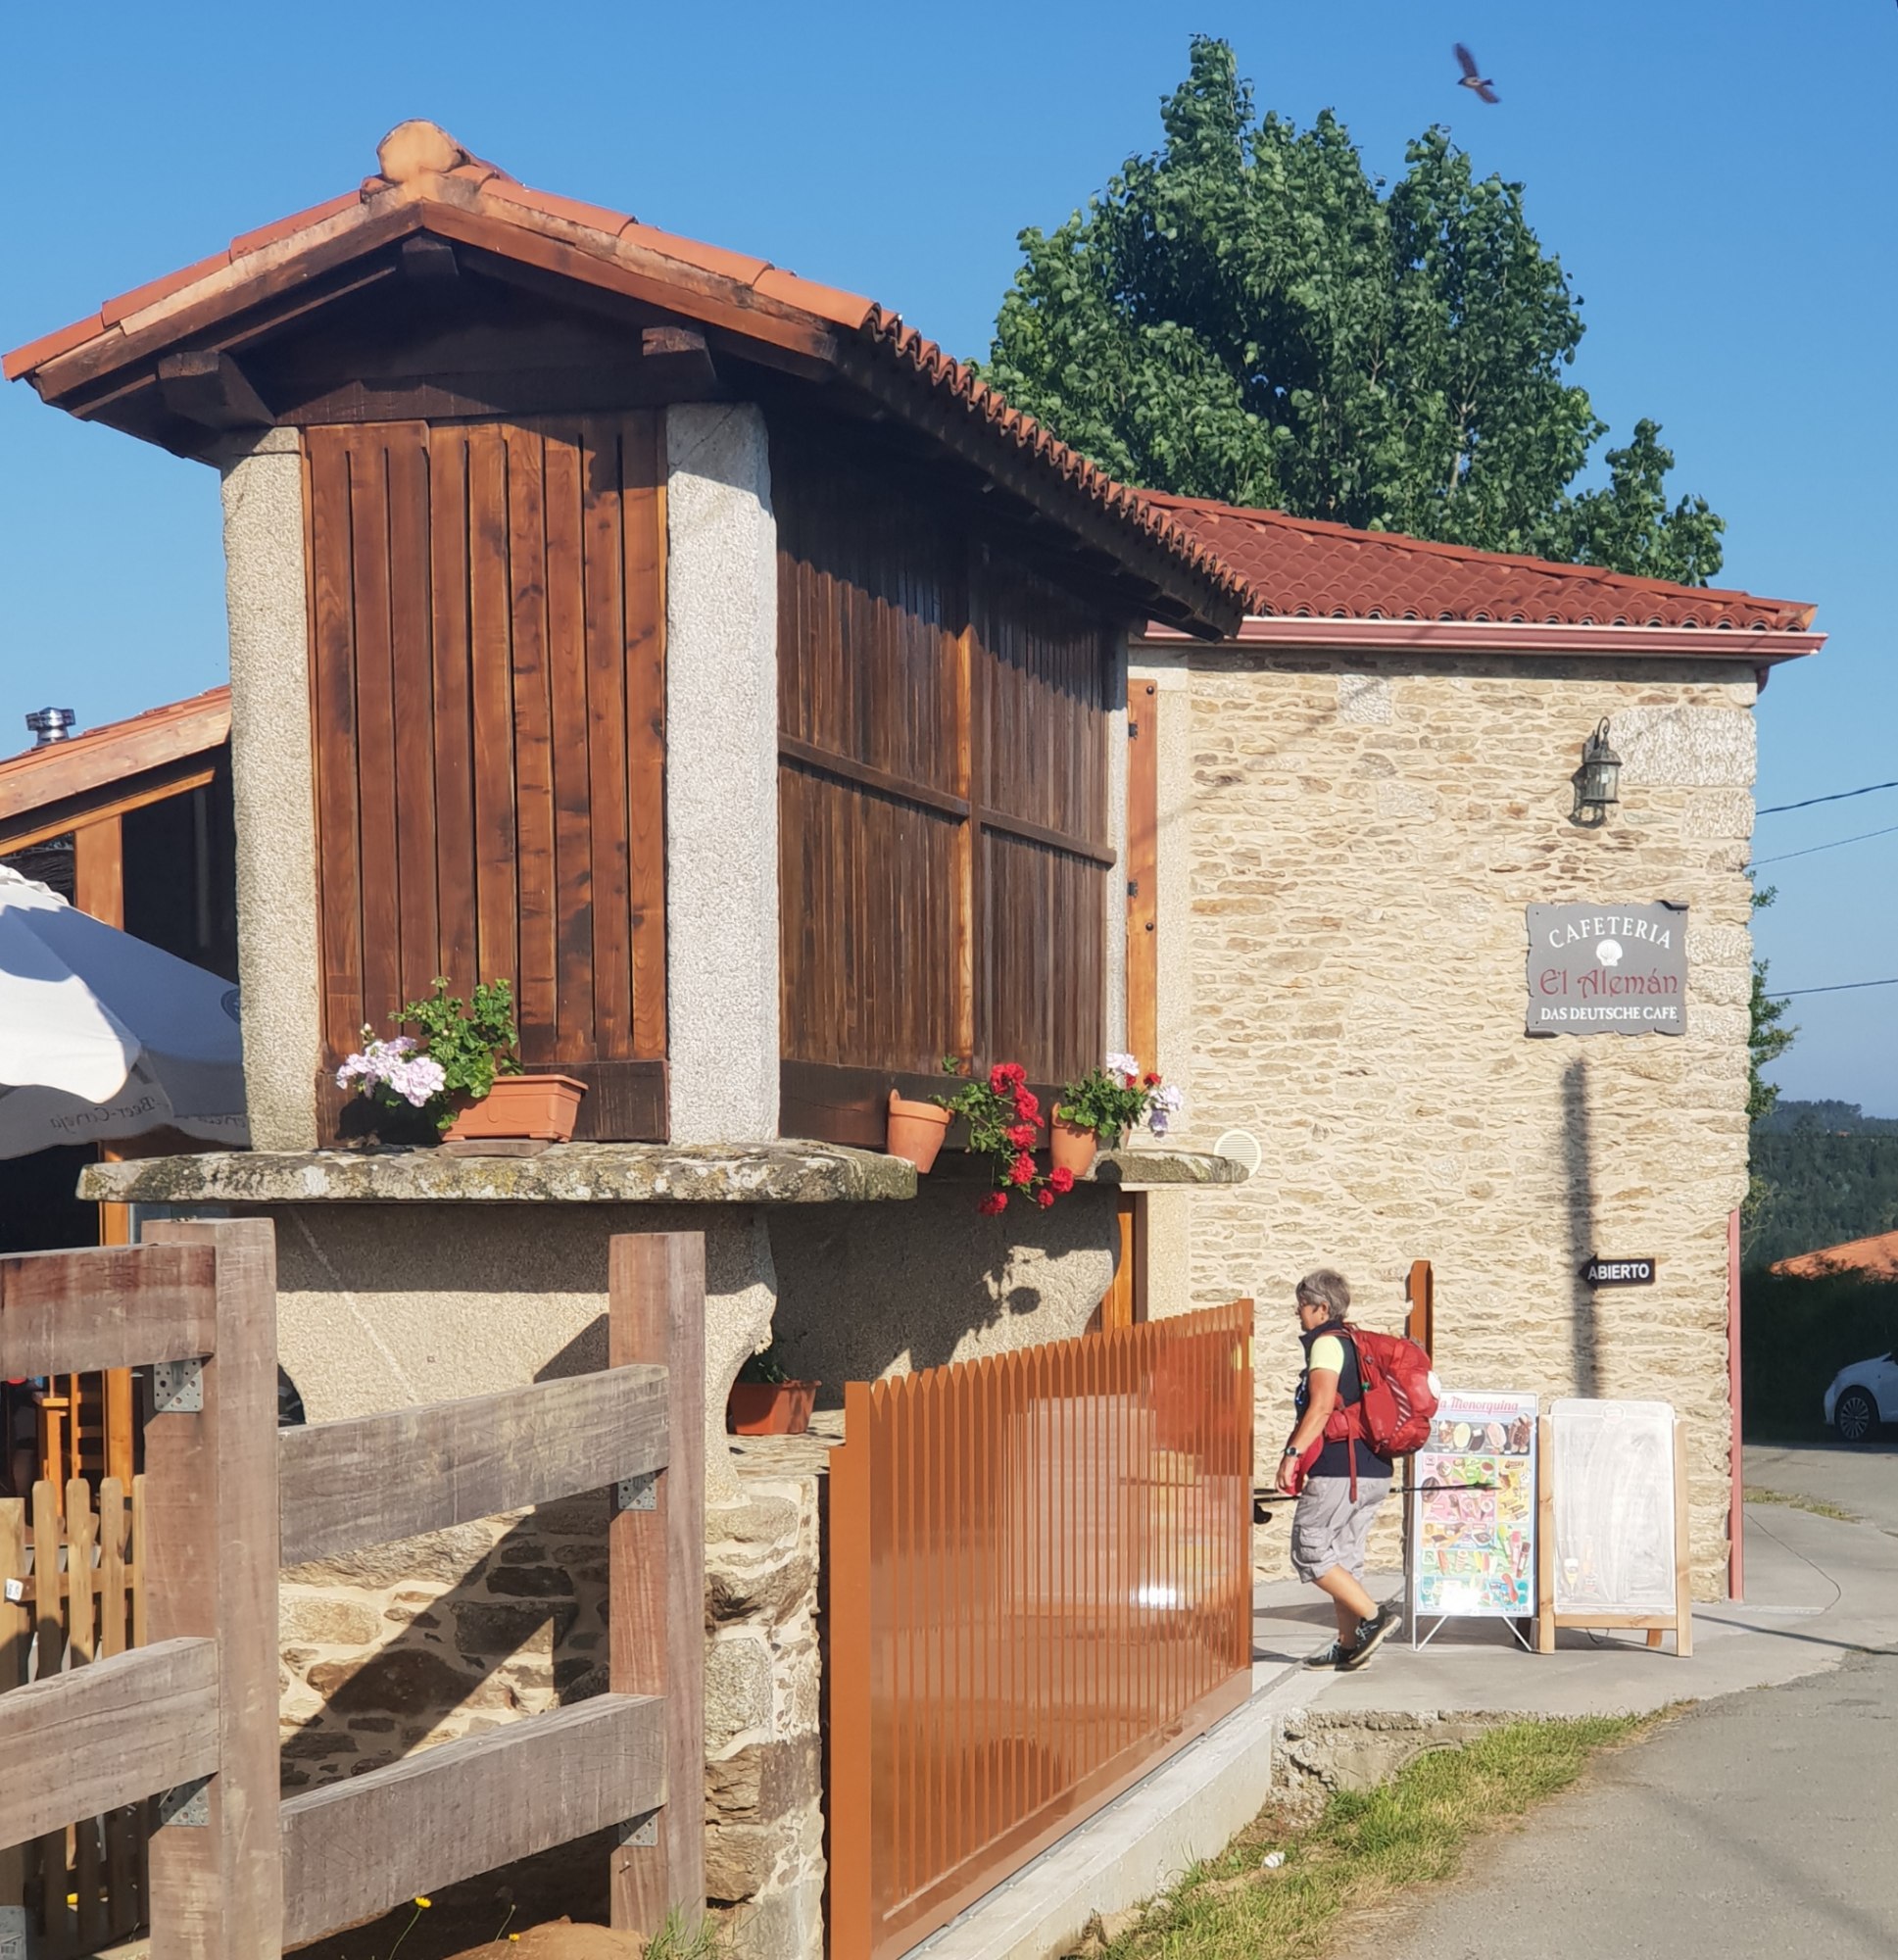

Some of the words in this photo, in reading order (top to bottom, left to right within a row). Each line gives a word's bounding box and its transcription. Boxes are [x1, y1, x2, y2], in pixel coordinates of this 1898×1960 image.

[1548, 916, 1671, 950] CAFETERIA
[1539, 968, 1568, 996] El
[1577, 967, 1678, 999] Alemán
[1540, 1007, 1568, 1020] DAS
[1570, 1006, 1640, 1020] DEUTSCHE
[1587, 1263, 1650, 1280] ABIERTO
[1450, 1396, 1519, 1414] Menorquina
